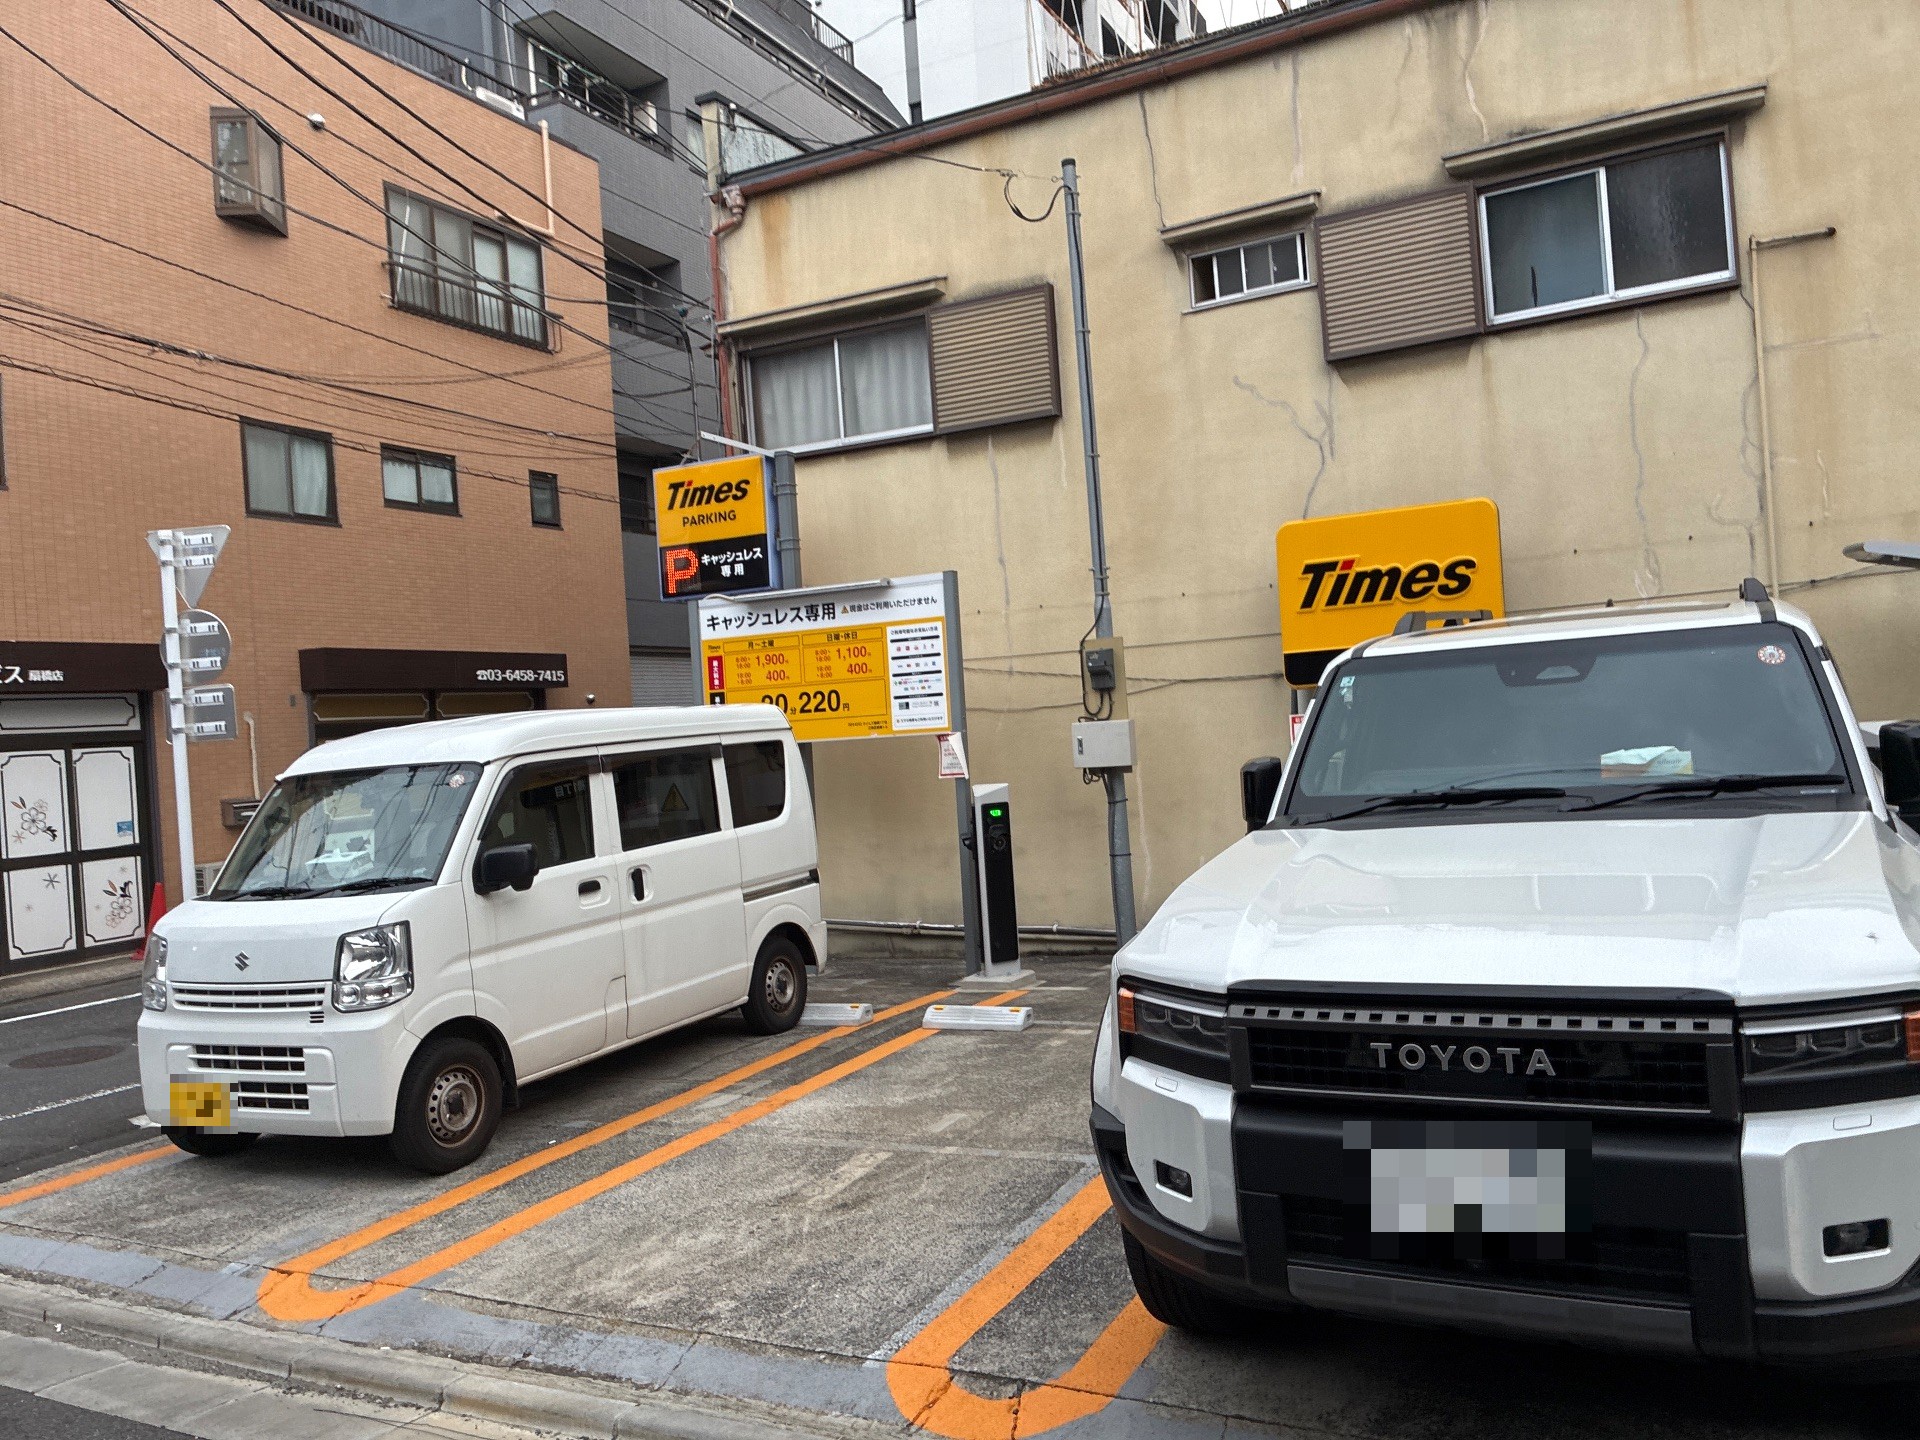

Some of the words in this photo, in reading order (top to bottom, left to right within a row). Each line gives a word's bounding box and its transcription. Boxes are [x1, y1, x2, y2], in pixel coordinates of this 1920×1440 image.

[667, 479, 751, 511] Times
[682, 510, 737, 527] PARKING
[701, 547, 763, 566] キャッシュレス
[666, 548, 699, 594] P
[720, 563, 745, 577] 専用
[1299, 558, 1477, 610] Times
[849, 597, 938, 613] 現金はご利用いただけません
[706, 602, 837, 631] キャッシュレス専用
[0, 664, 24, 684] ス
[486, 668, 565, 681] 03-6458-7415
[1369, 1042, 1557, 1076] TOYOTA
